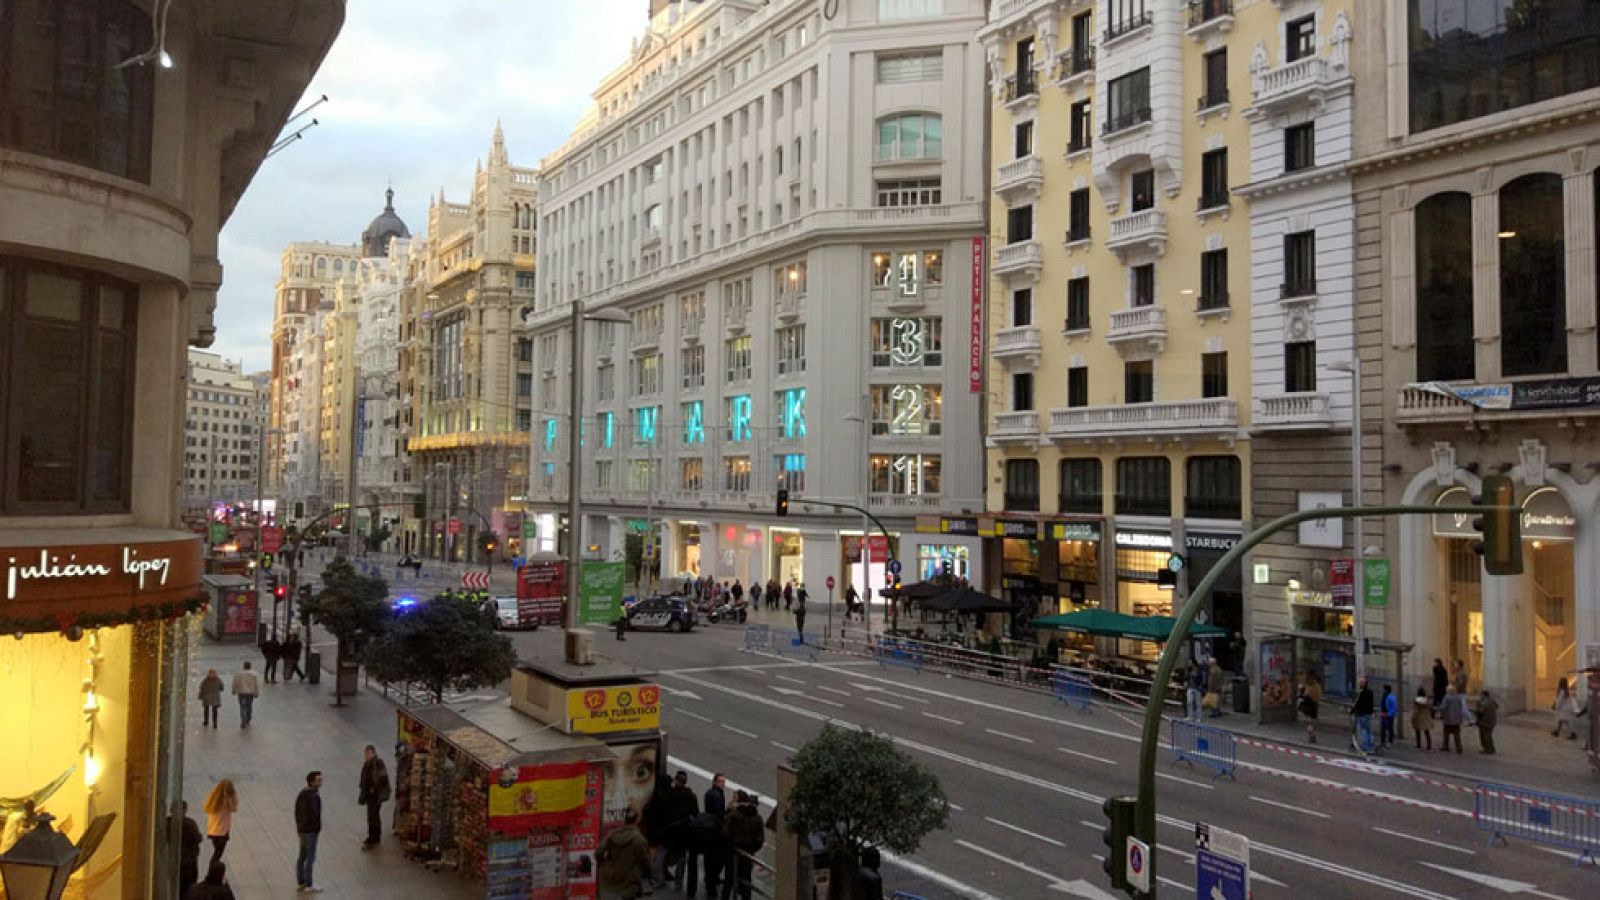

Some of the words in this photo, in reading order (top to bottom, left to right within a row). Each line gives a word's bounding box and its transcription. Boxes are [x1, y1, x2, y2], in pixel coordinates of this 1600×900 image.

[884, 254, 917, 295] 4
[973, 244, 981, 297] PETIT
[892, 317, 922, 364] 3
[971, 302, 980, 367] PALACE
[545, 387, 806, 451] PIMARK
[892, 384, 922, 433] 2
[893, 453, 921, 496] 1
[1065, 524, 1092, 537] pans
[1116, 533, 1172, 547] CALZEDONIA
[1186, 536, 1240, 550] STARBUCK
[7, 549, 111, 599] julián
[123, 546, 170, 590] lópez
[590, 709, 609, 719] BUS
